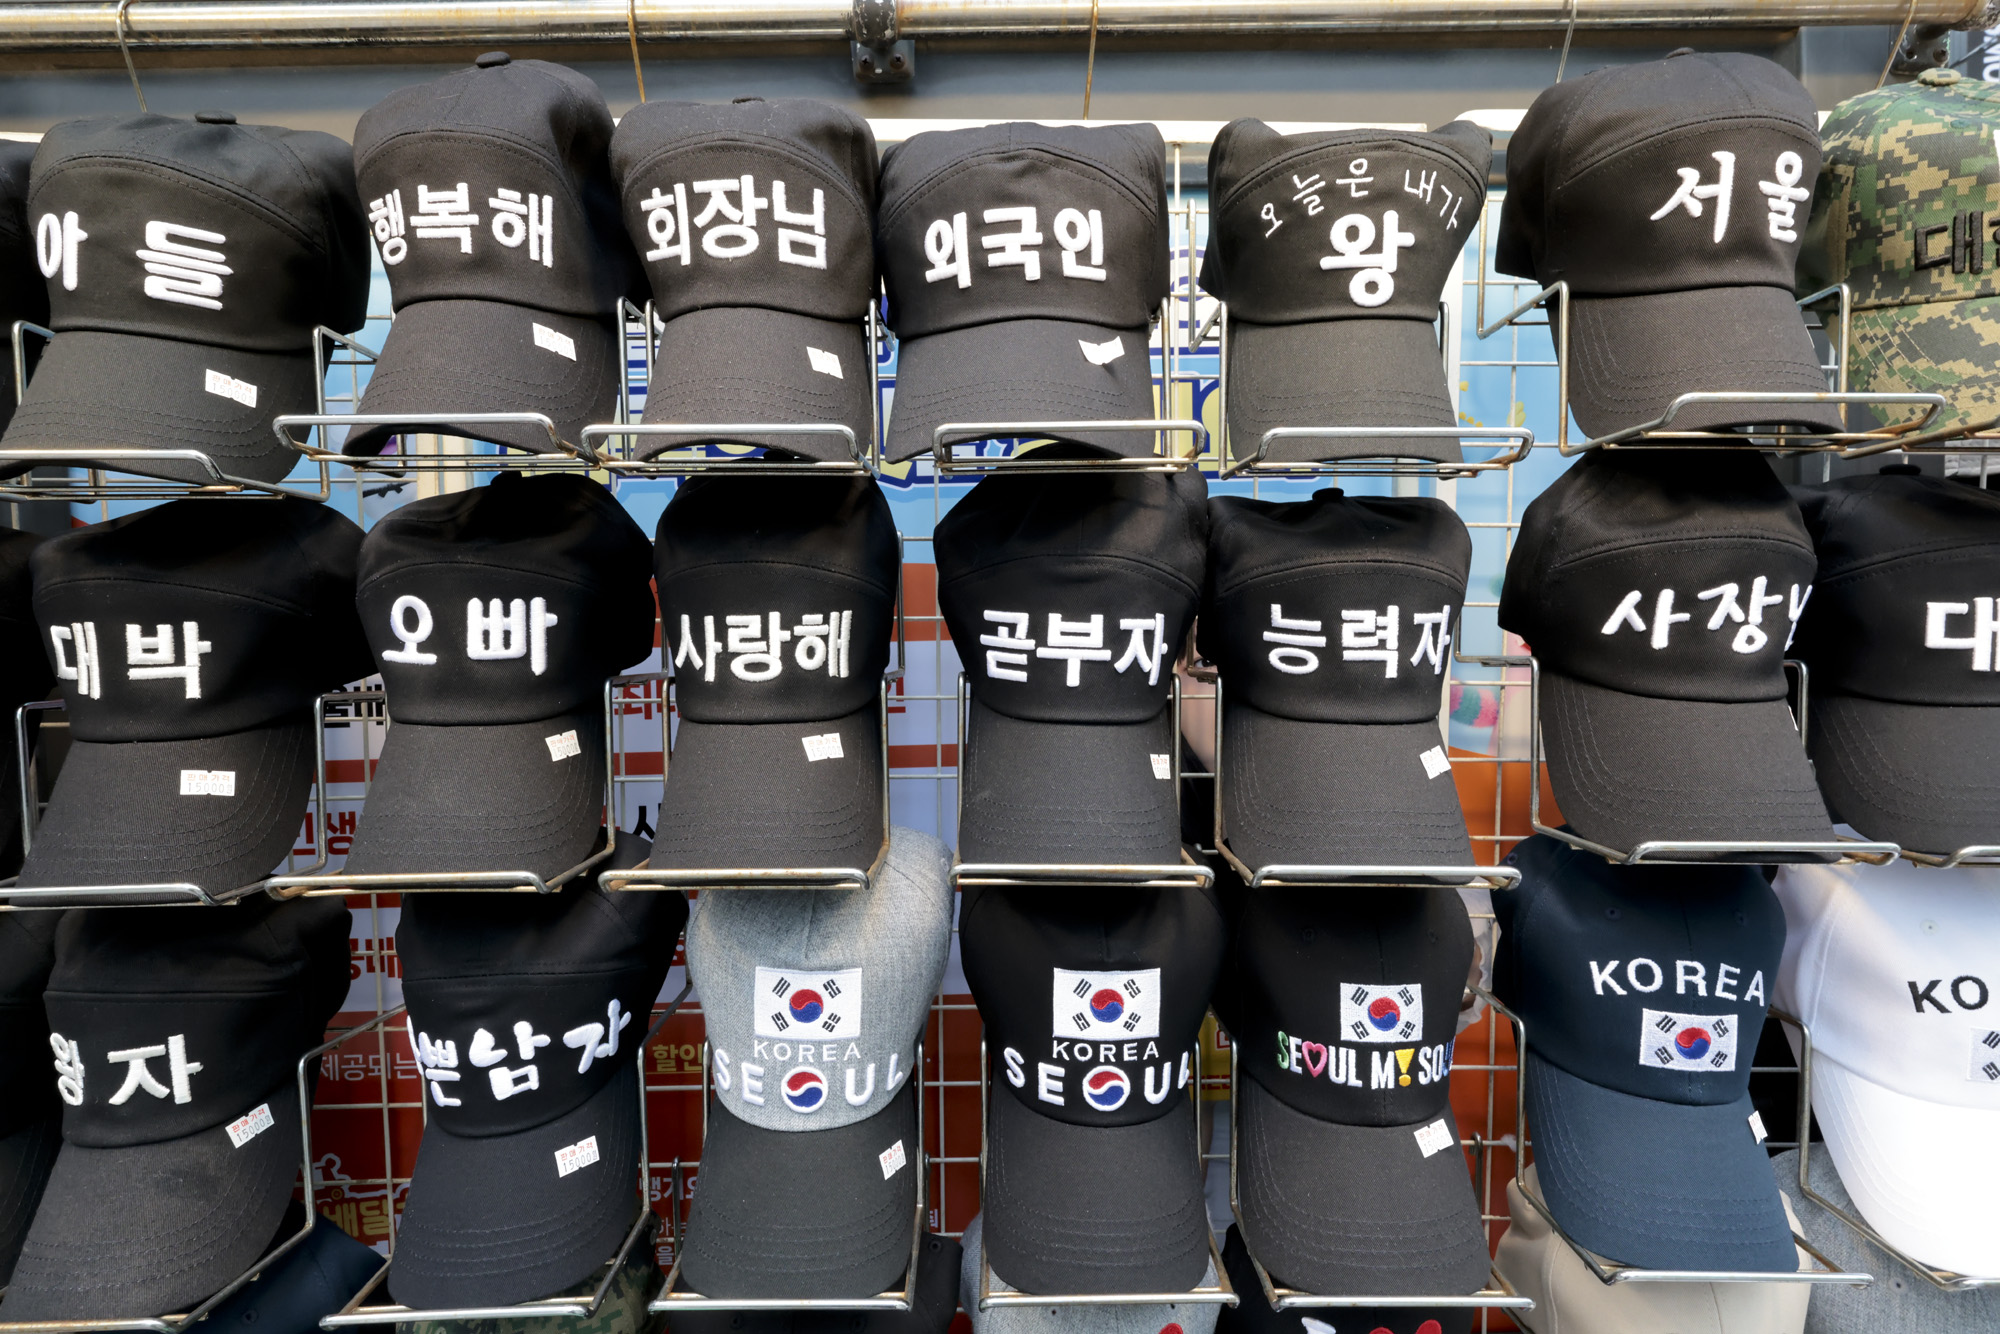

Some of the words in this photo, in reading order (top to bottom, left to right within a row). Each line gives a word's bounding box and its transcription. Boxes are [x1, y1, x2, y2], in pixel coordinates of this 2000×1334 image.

[369, 181, 554, 268] 행복해
[640, 174, 828, 270] 회장님
[1261, 157, 1374, 237] 오늘은
[1404, 167, 1464, 231] 내가
[1650, 150, 1811, 244] 서울
[37, 211, 234, 311] 아들
[924, 206, 1108, 289] 외국인
[1319, 208, 1416, 308] 왕
[50, 620, 212, 701] 대박
[381, 594, 558, 677] 오빠
[675, 610, 853, 683] 사랑해
[980, 610, 1169, 688] 곧부자
[1263, 603, 1452, 680] 능력자
[187, 773, 231, 783] 판매가격
[1589, 959, 1765, 1006] KOREA
[49, 1032, 204, 1106] 왕자
[753, 1038, 861, 1065] KOREA
[1053, 1038, 1160, 1064] KOREA
[231, 1107, 266, 1134] 판매가격
[560, 1141, 594, 1162] 판매가격
